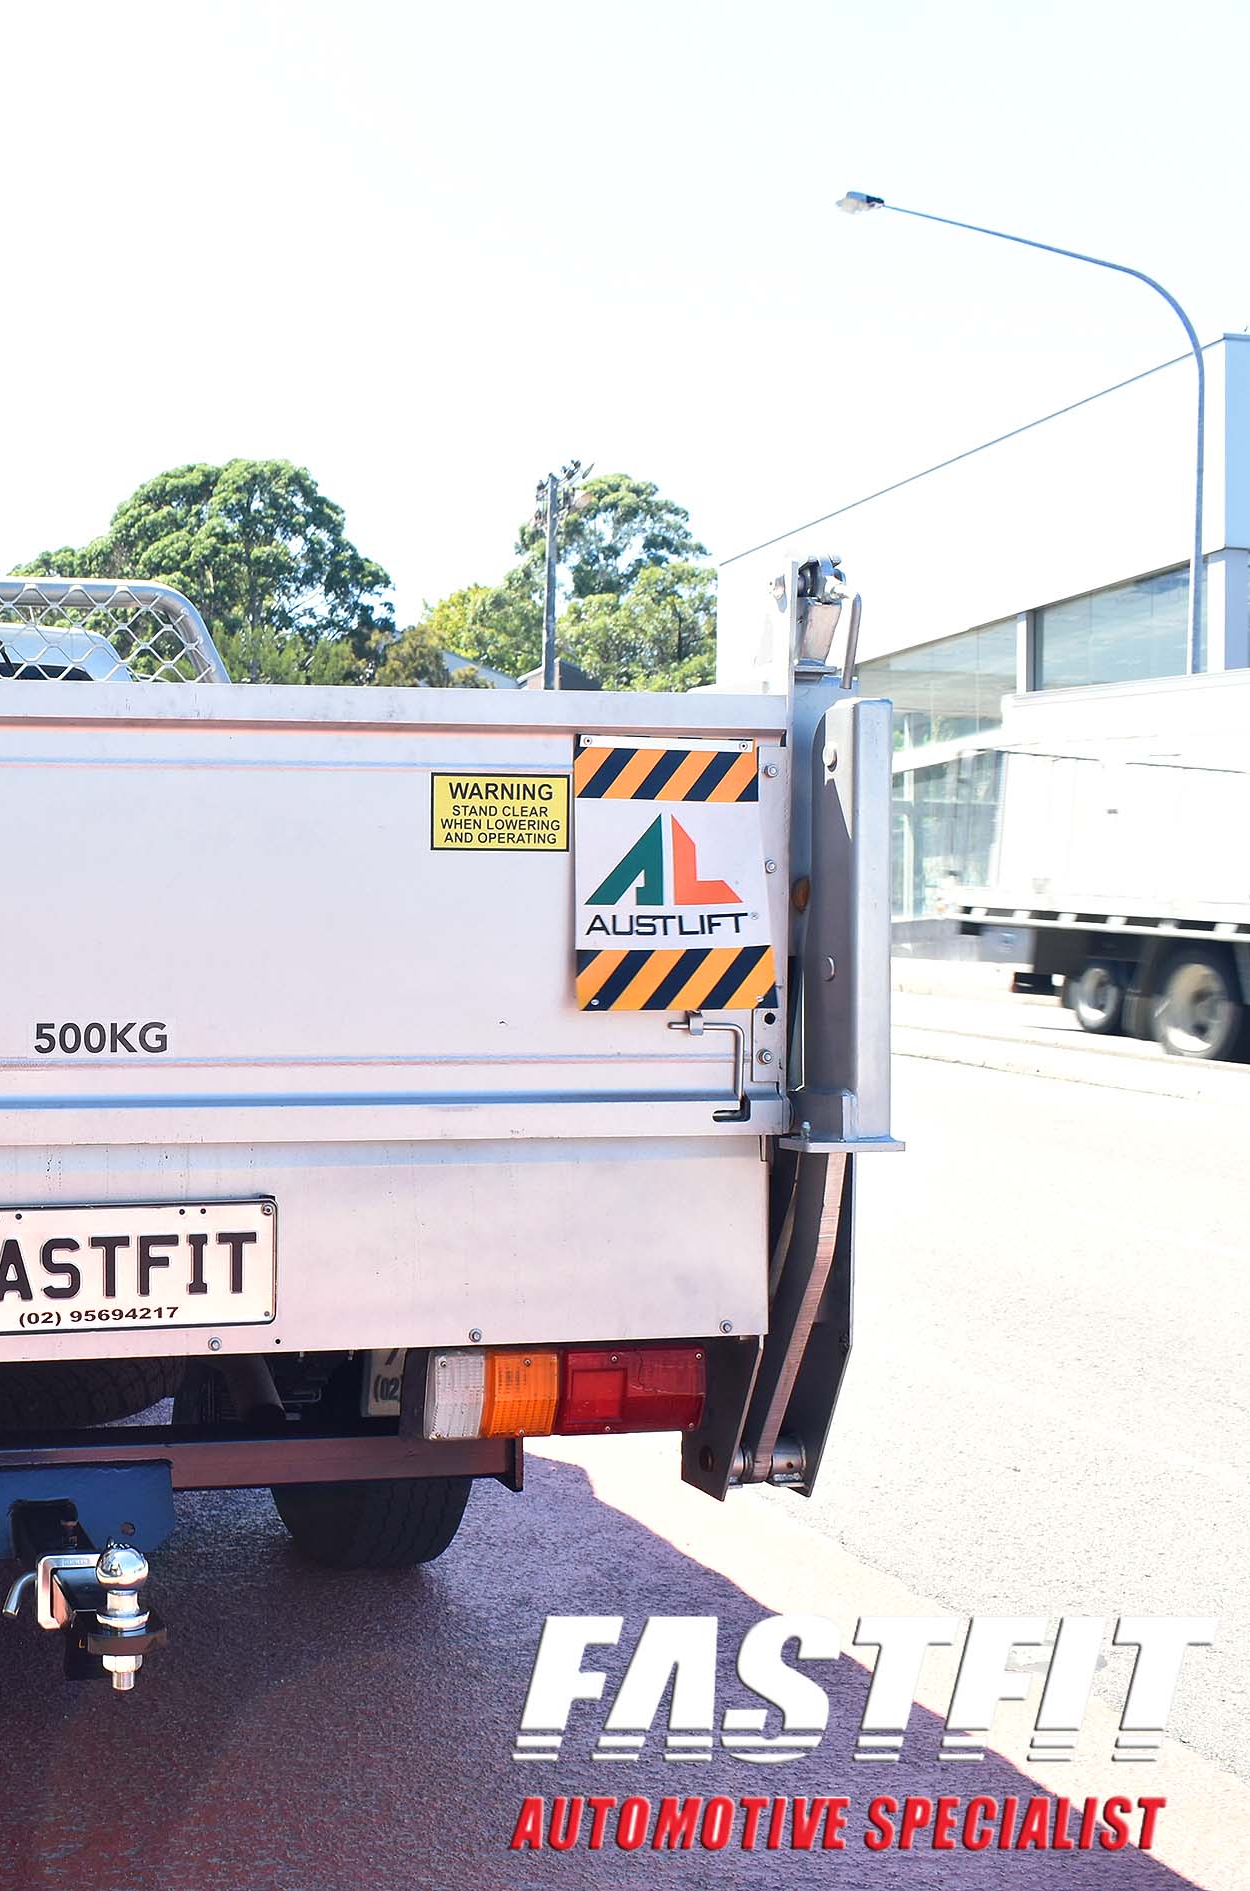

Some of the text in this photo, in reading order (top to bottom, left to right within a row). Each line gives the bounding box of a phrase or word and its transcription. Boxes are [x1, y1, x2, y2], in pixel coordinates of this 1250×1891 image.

[448, 782, 553, 800] WARNING
[452, 804, 548, 817] STAND CLEAR
[440, 818, 561, 831] WHEN LOWERING
[444, 831, 557, 844] AND OPERATING
[585, 912, 749, 937] AUSTLIFT
[34, 1021, 168, 1054] 500KG
[19, 1306, 179, 1328] (02) 95694217
